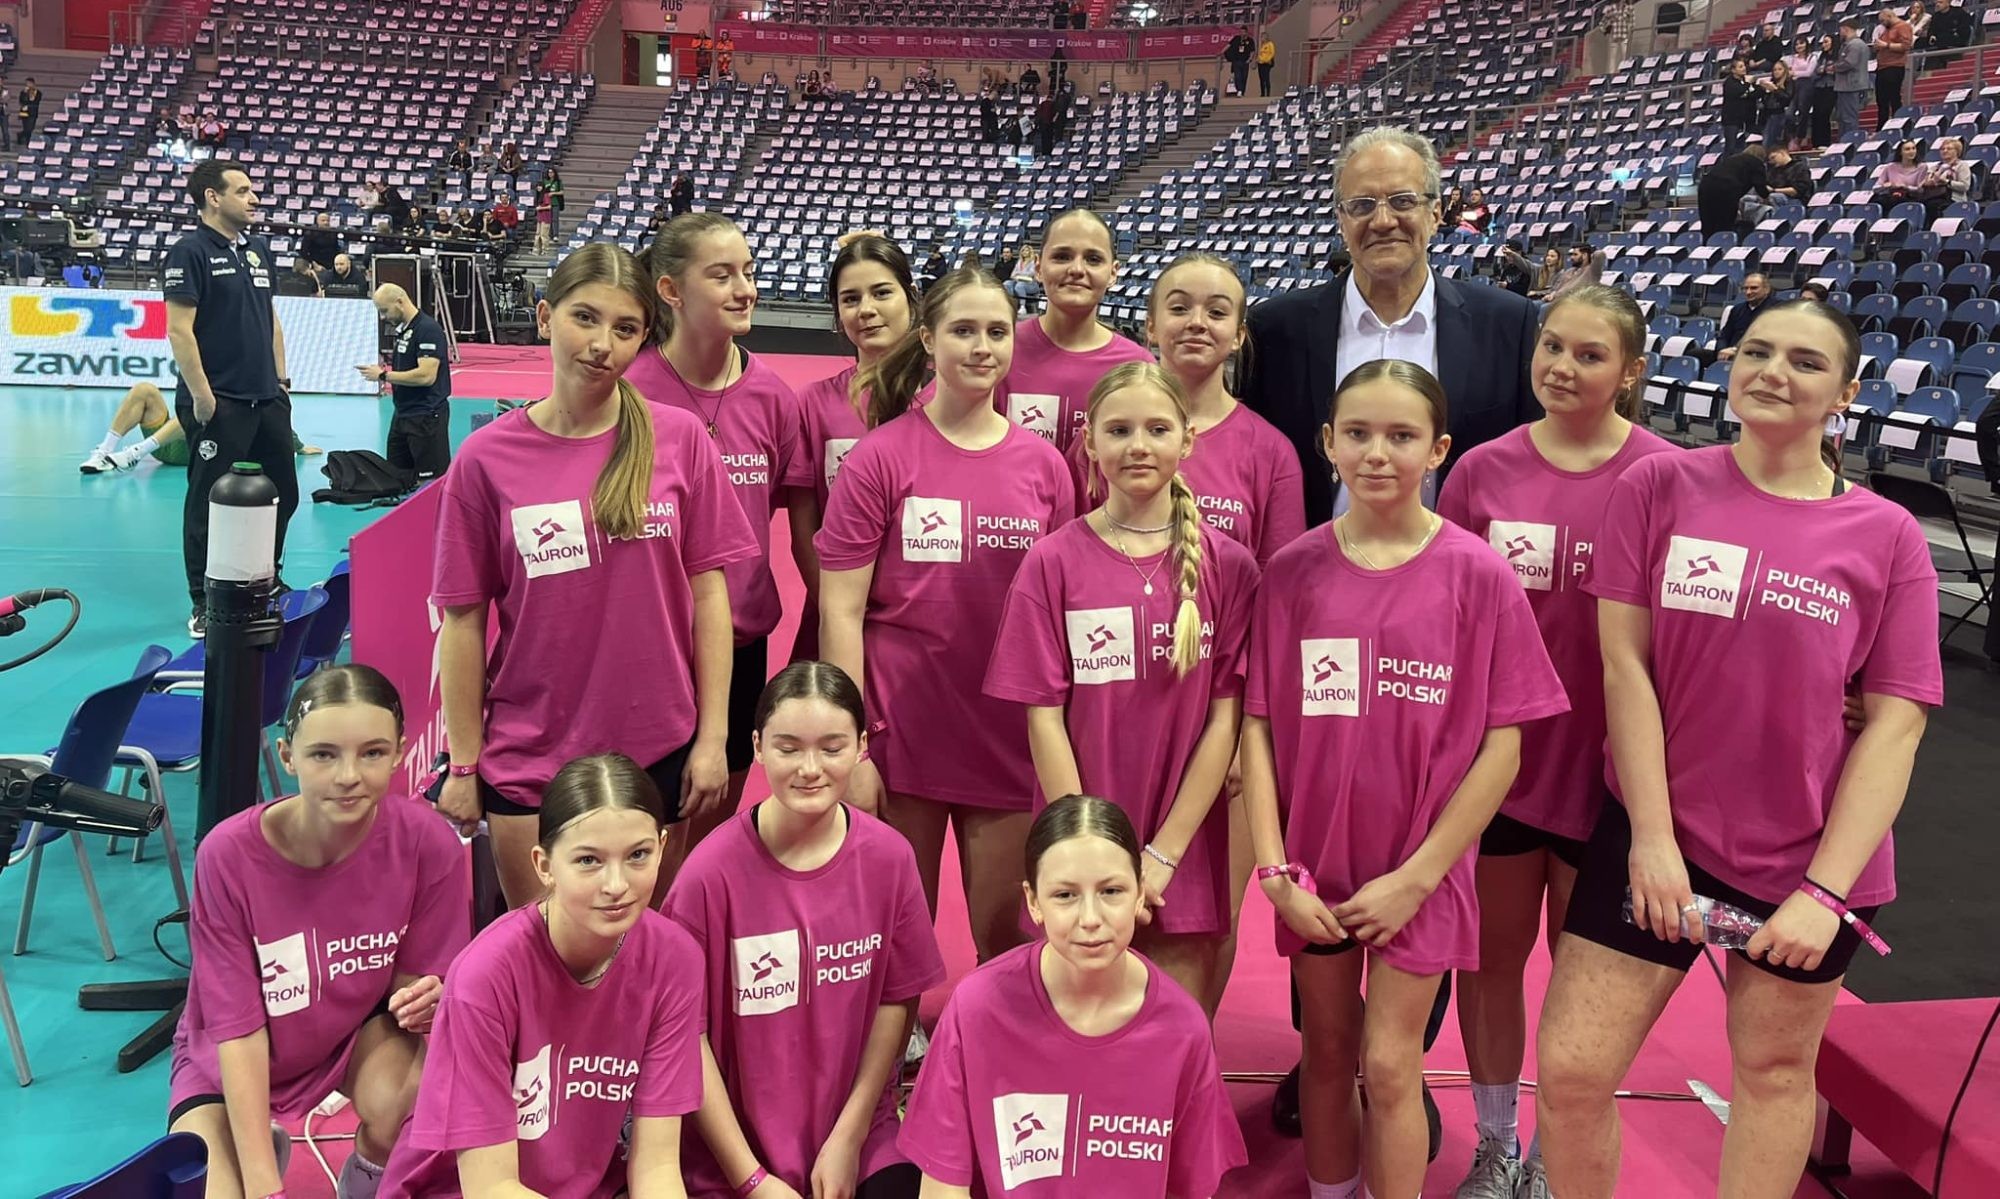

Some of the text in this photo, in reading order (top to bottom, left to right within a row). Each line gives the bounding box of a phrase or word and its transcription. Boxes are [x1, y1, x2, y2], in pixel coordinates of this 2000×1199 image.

[720, 454, 769, 467] PUCHA
[728, 472, 768, 485] OLSKI
[643, 502, 675, 518] HAR
[976, 515, 1040, 533] PUCHAR
[1206, 514, 1234, 530] SKI
[906, 538, 959, 550] TAURON
[976, 534, 1034, 550] POLSKI
[524, 544, 584, 565] TAURON
[1666, 581, 1734, 603] TAURON
[1766, 568, 1850, 609] PUCHAR
[1760, 589, 1840, 626] POLSKI
[1074, 654, 1131, 671] TAURON
[1378, 657, 1453, 682] PUCHAR
[1377, 680, 1446, 705] POLSKI
[816, 933, 882, 963] PUCHAR
[328, 950, 396, 981] POLSK
[816, 958, 872, 986] POLSKI
[264, 984, 305, 1003] RON
[735, 980, 795, 1002] TAURON
[568, 1055, 639, 1078] PUCHA
[565, 1080, 636, 1101] POLSK
[1086, 1139, 1163, 1162] POLSKI
